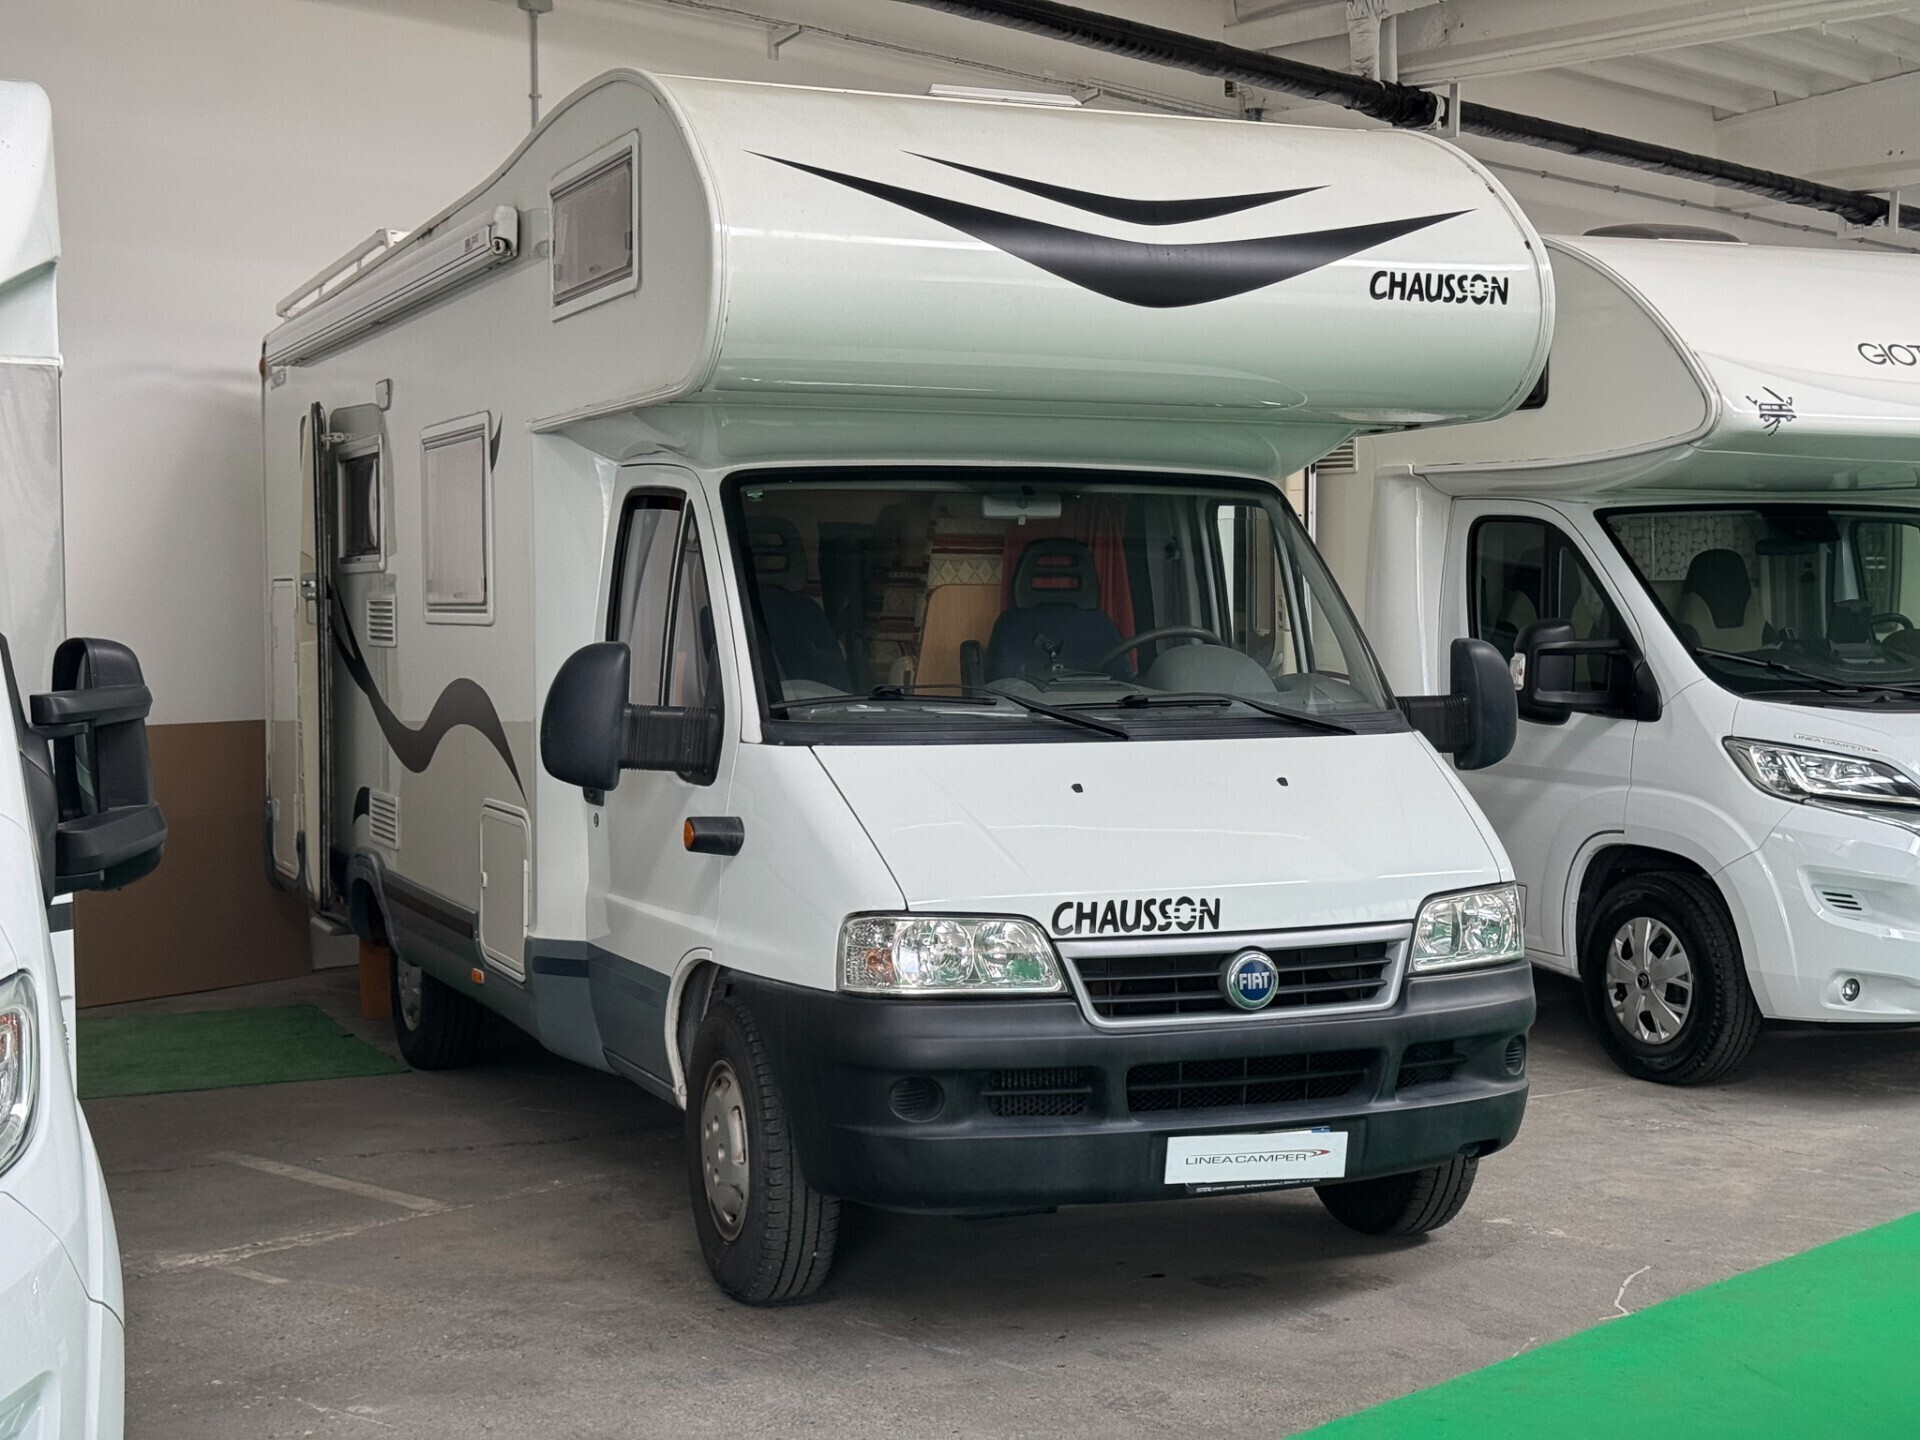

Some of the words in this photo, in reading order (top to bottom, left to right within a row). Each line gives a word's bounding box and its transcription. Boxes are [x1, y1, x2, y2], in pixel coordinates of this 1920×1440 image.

[1369, 270, 1509, 305] CHAUSSON
[1052, 896, 1220, 936] CHAUSSON
[1239, 972, 1270, 990] FIAT
